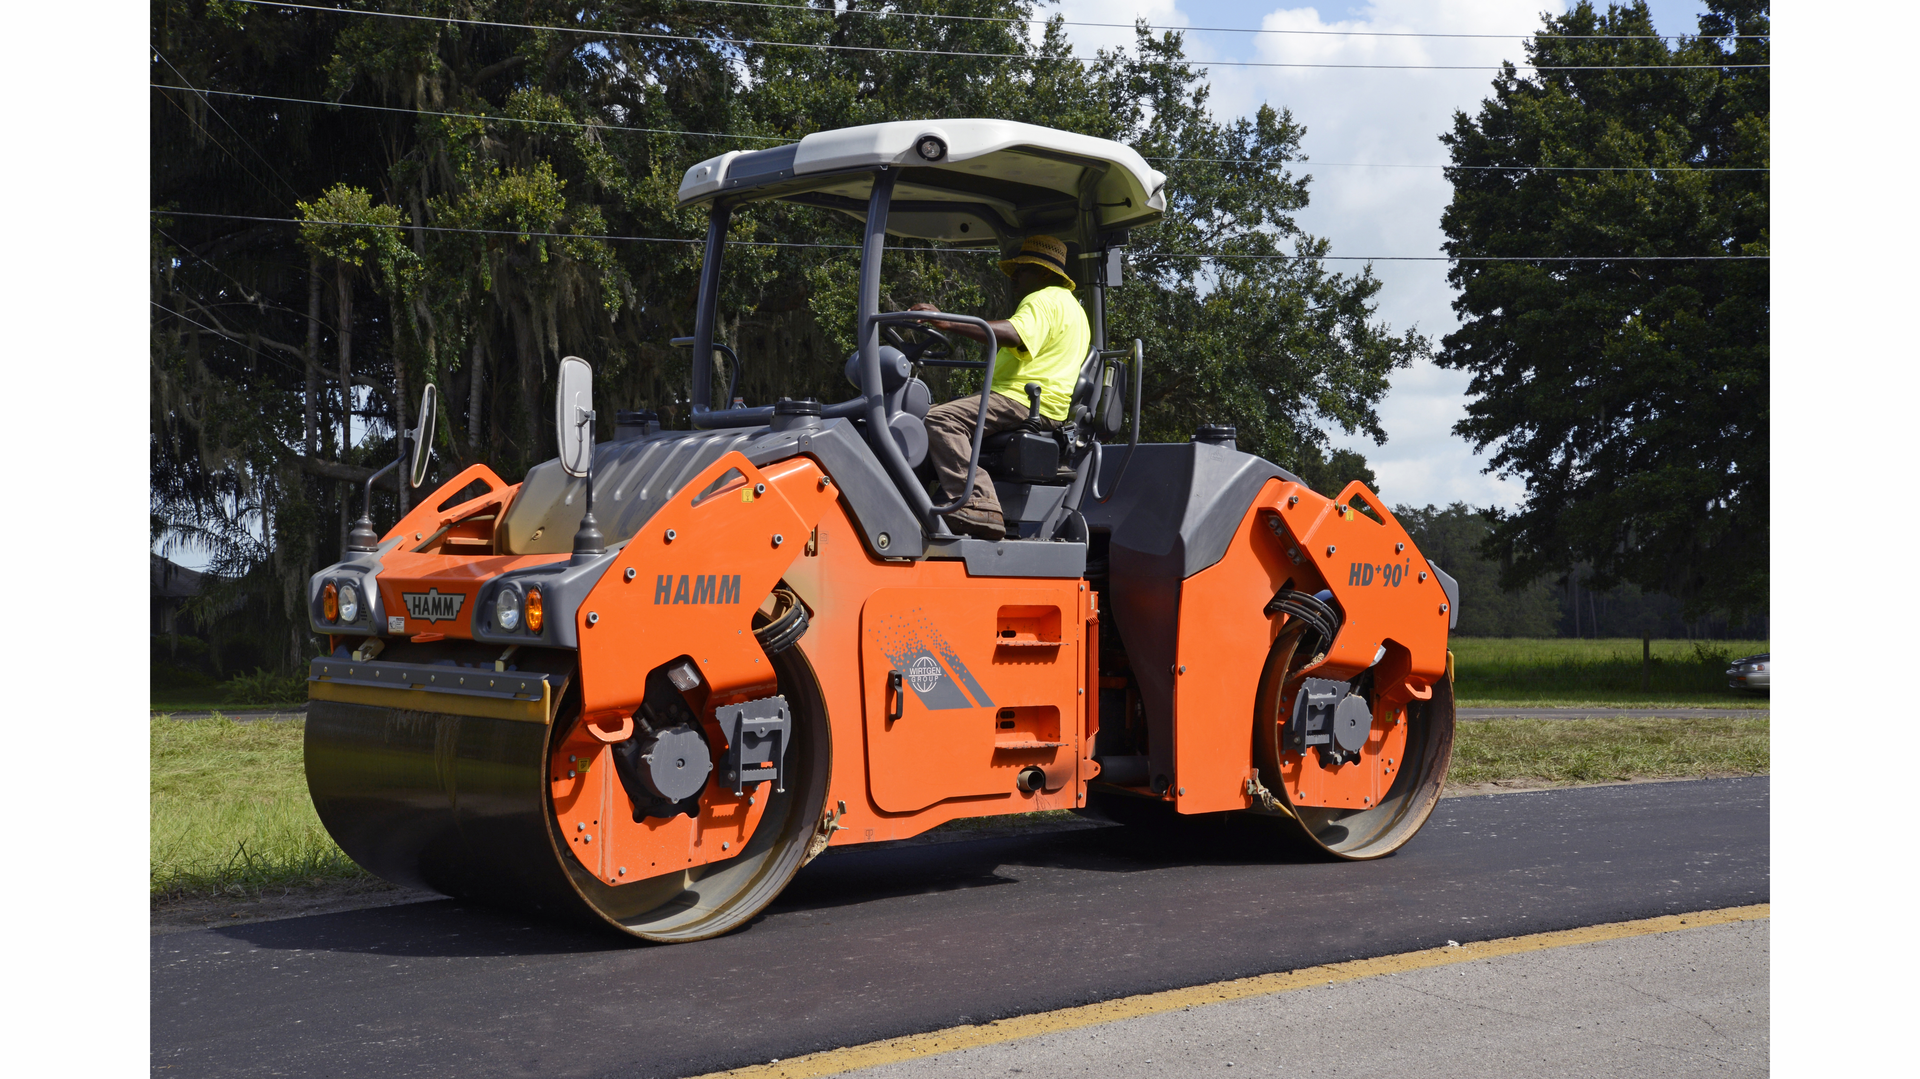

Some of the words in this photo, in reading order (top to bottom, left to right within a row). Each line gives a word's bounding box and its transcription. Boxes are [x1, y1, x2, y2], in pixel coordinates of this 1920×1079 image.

[654, 574, 741, 605] HAMM
[412, 596, 454, 617] HAMM
[909, 666, 941, 675] WIRTGEN
[911, 675, 939, 683] GROUP
